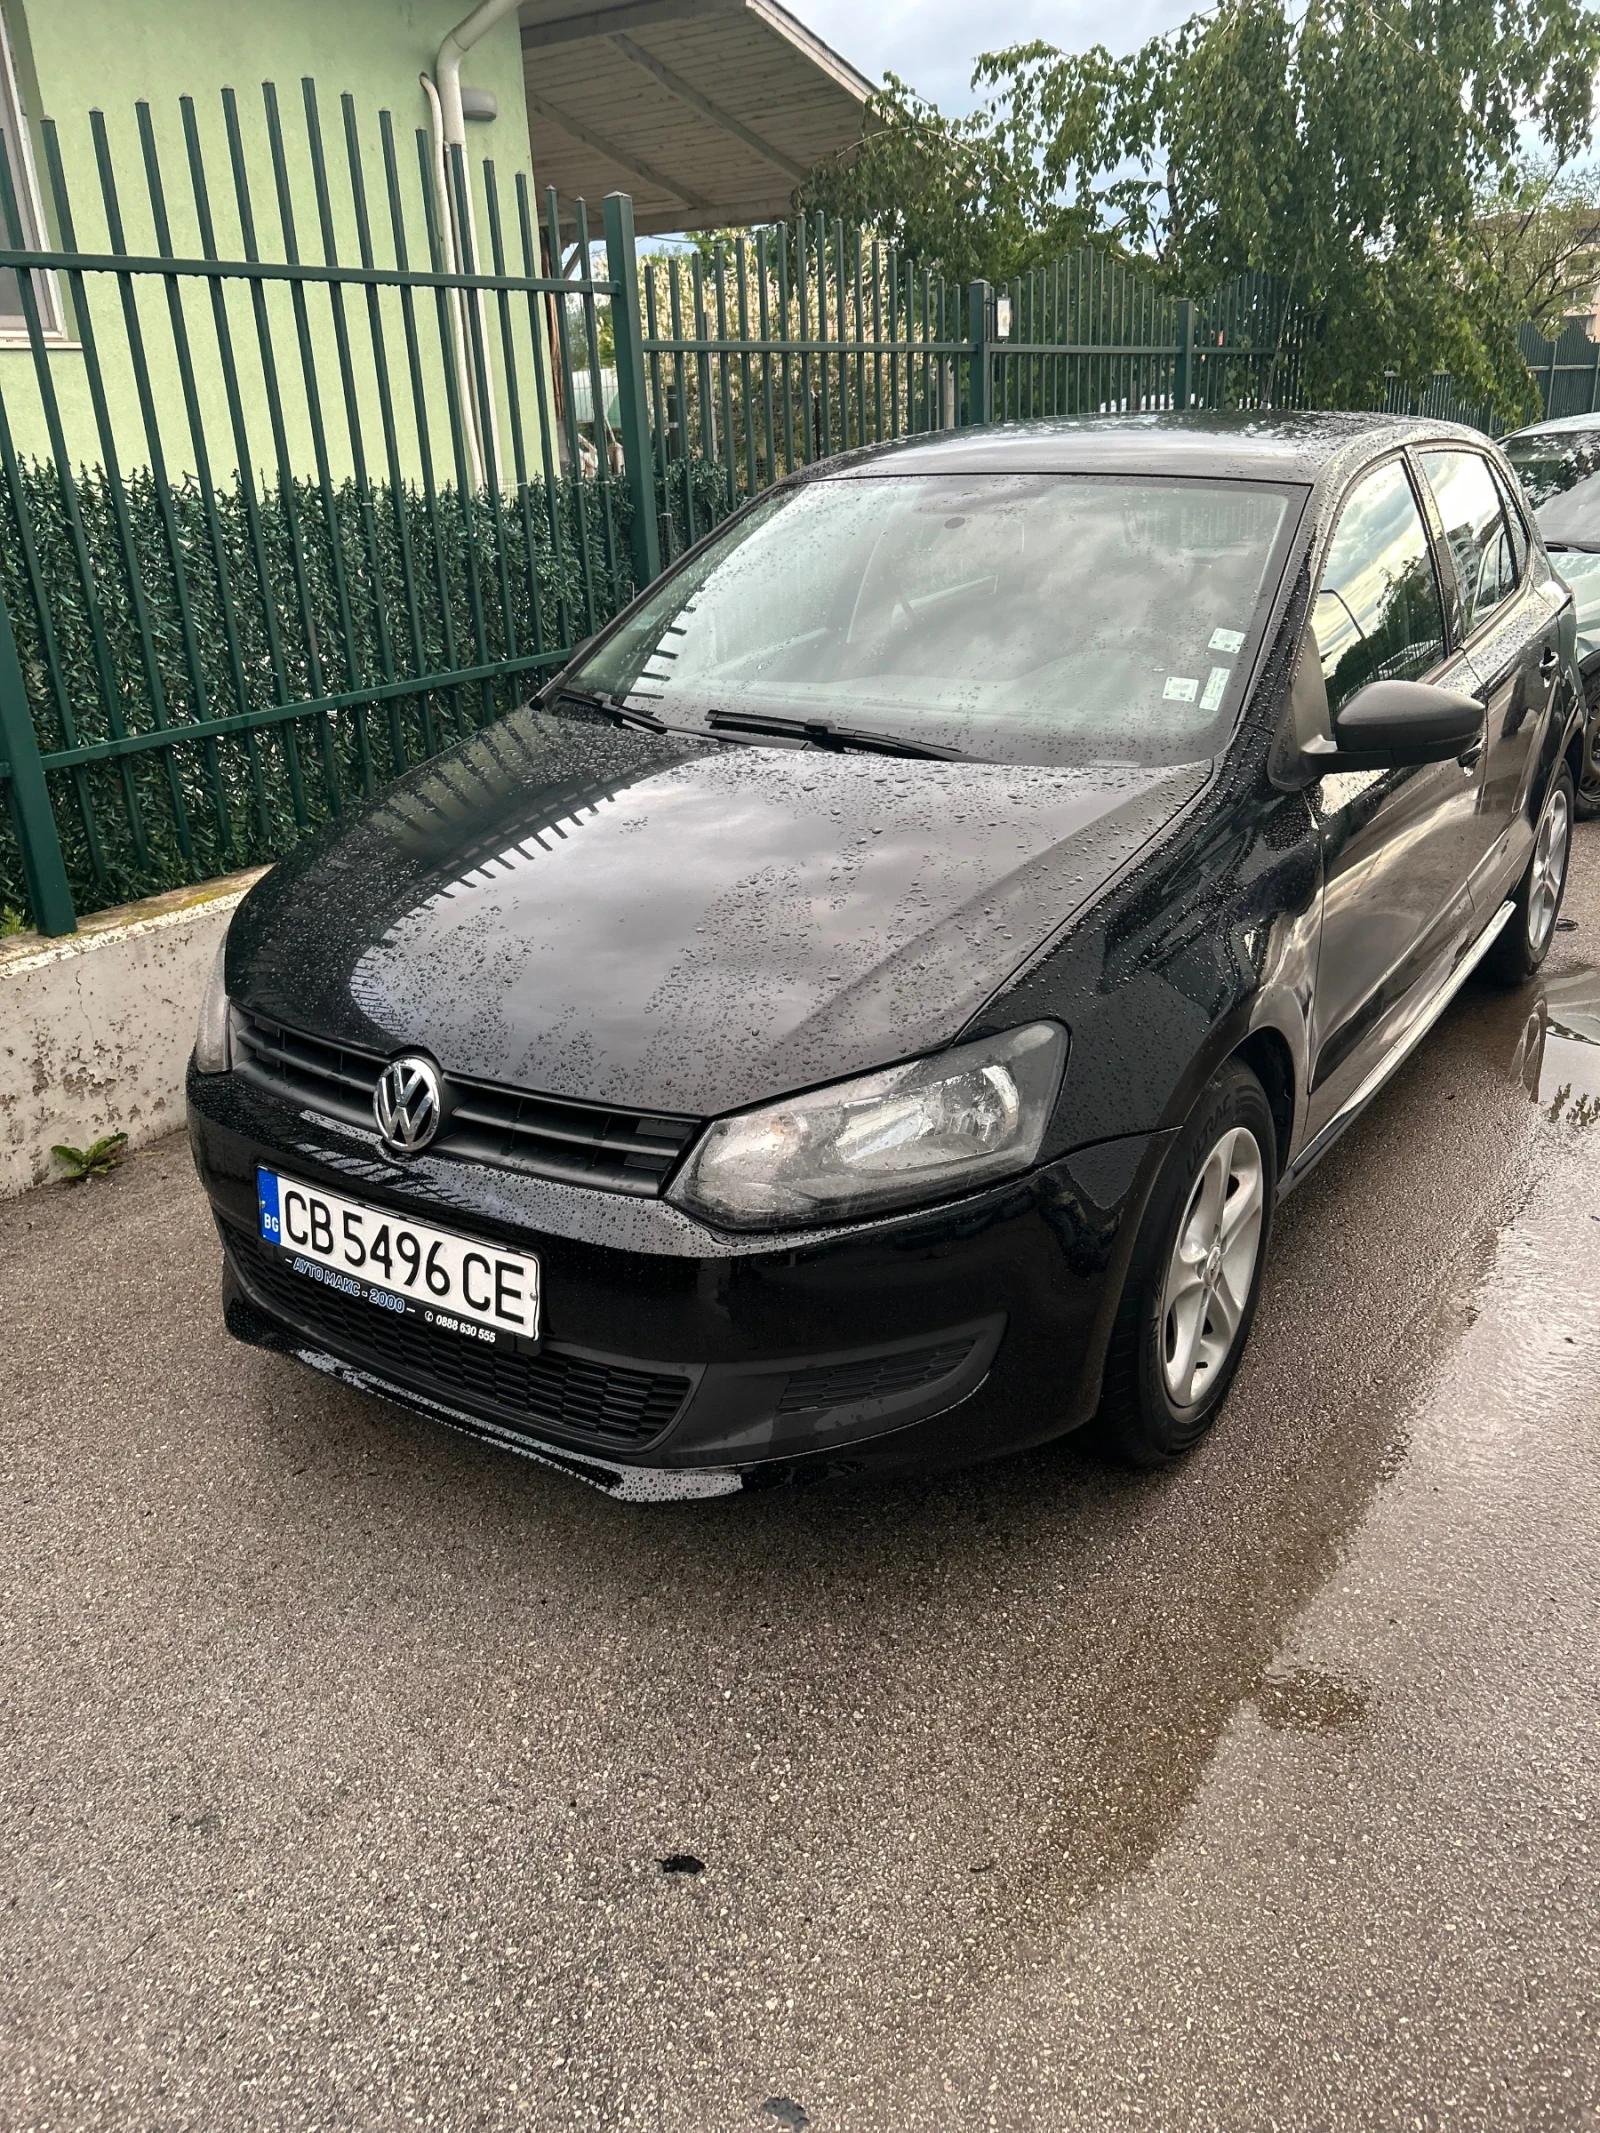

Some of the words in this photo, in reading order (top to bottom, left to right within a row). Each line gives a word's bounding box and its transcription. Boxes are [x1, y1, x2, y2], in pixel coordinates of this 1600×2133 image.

[264, 1212, 279, 1233] BG
[285, 1190, 334, 1255] CB
[342, 1210, 450, 1296] 5496
[463, 1252, 525, 1325] CE
[368, 1288, 406, 1314] 2000
[436, 1314, 459, 1331] 0888
[459, 1322, 477, 1337] 630
[478, 1328, 496, 1343] 555
